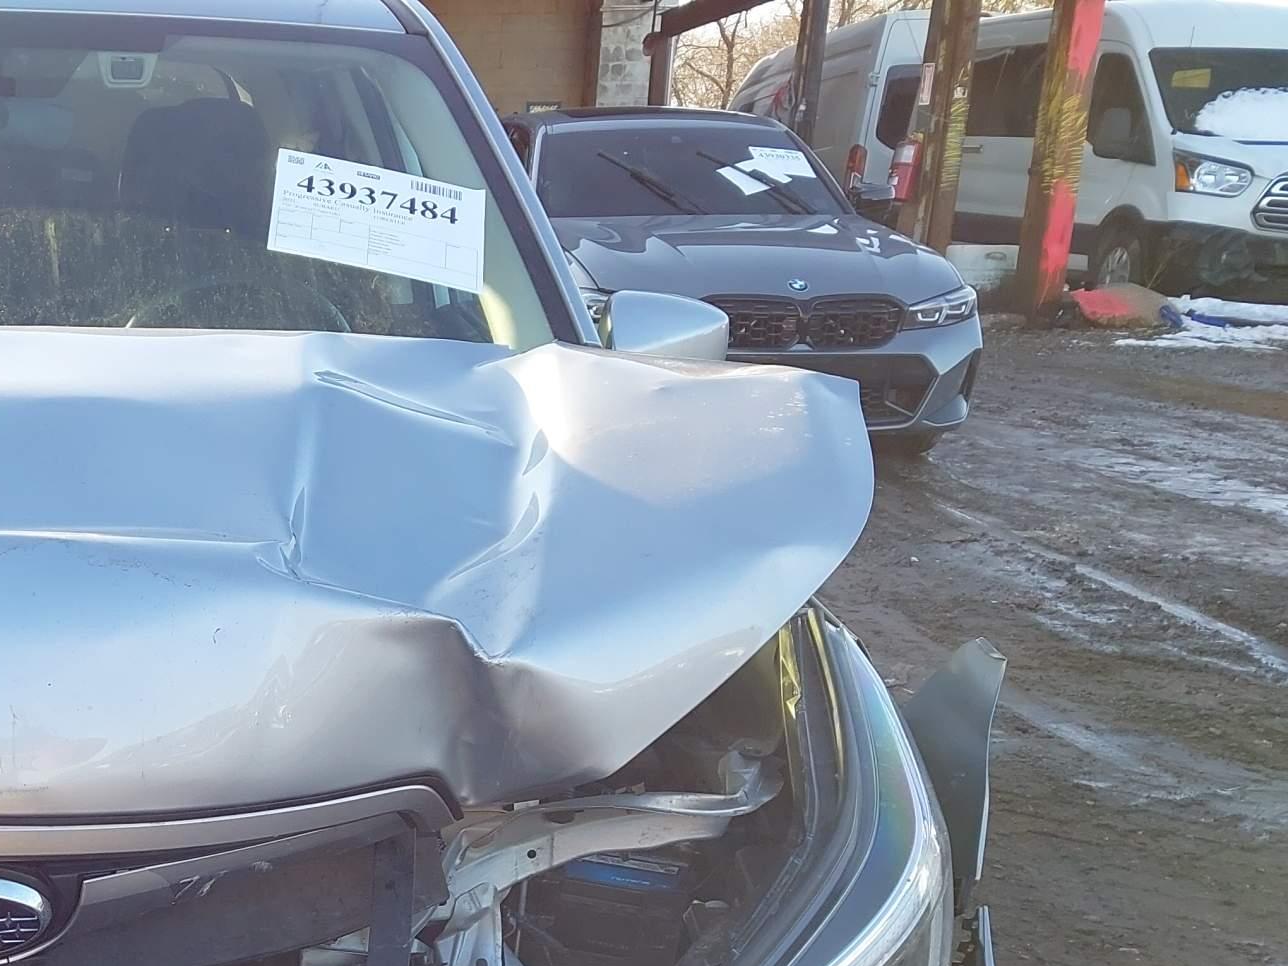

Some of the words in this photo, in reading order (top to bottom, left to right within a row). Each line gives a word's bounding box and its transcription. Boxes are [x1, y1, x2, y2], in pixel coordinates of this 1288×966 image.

[283, 189, 332, 204] Progressive
[374, 207, 413, 221] Insurance
[297, 175, 458, 224] 43937484
